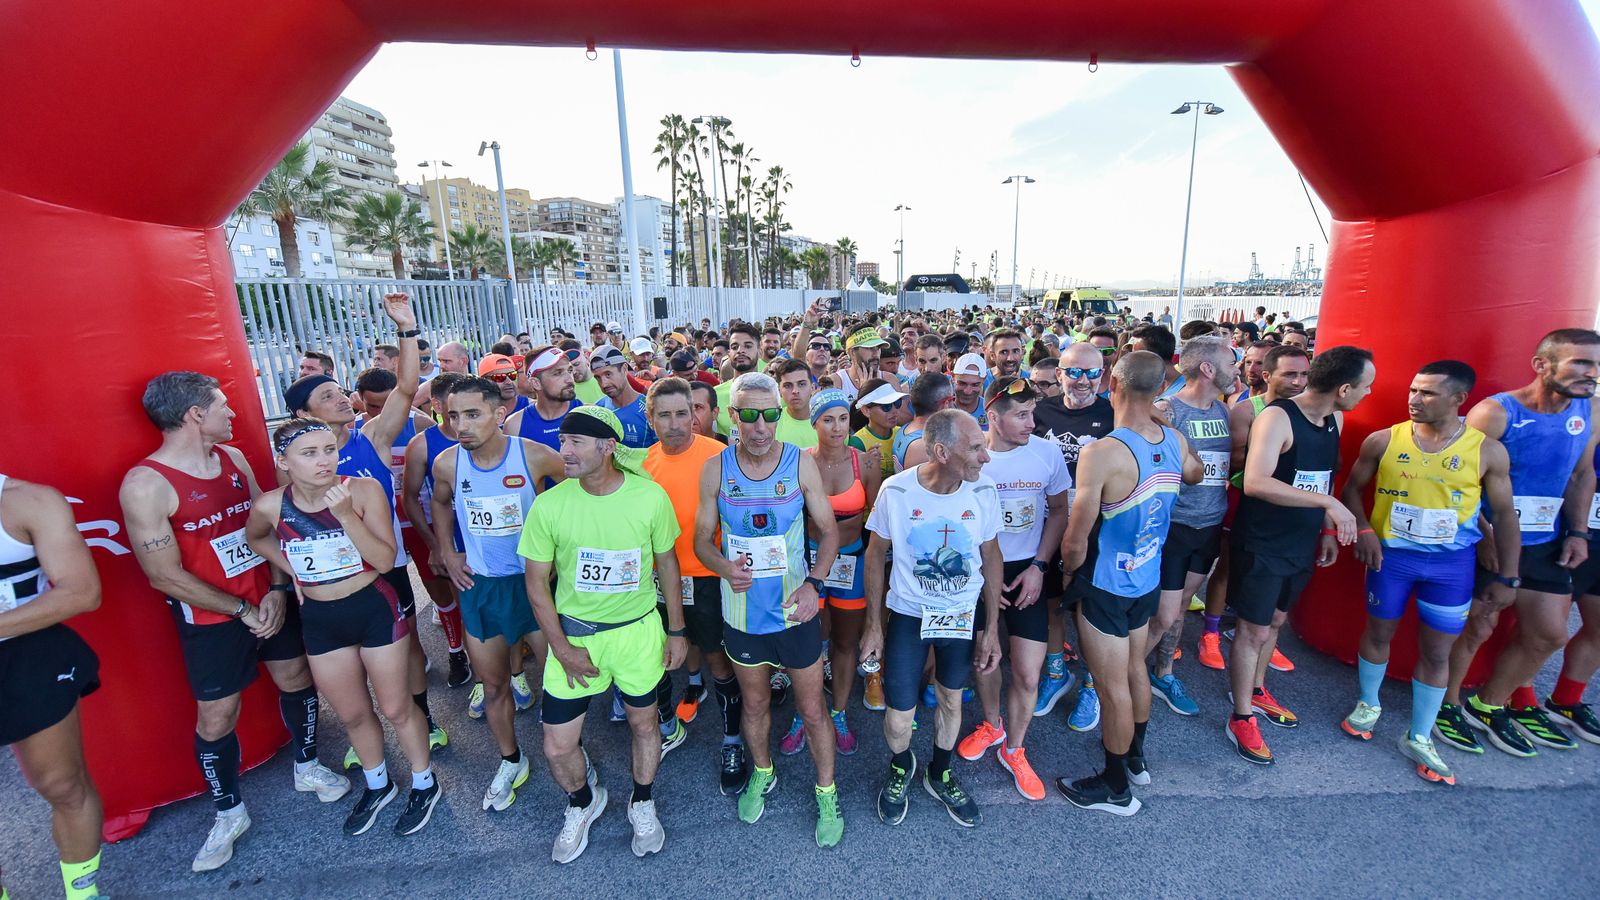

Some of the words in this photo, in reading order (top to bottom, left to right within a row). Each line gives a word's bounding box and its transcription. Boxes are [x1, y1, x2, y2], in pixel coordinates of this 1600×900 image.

[1202, 421, 1227, 437] RUN
[1203, 463, 1216, 477] 06
[1009, 479, 1042, 489] urbano
[183, 511, 223, 531] SAN
[226, 499, 253, 518] PED
[1395, 505, 1407, 513] XXI
[470, 511, 493, 526] 219
[1406, 518, 1414, 531] 1
[215, 540, 228, 550] XXI
[226, 543, 253, 564] 743
[304, 557, 316, 571] 2
[581, 564, 612, 582] 537
[916, 575, 938, 593] Vive
[939, 575, 950, 592] la
[928, 615, 954, 627] 742
